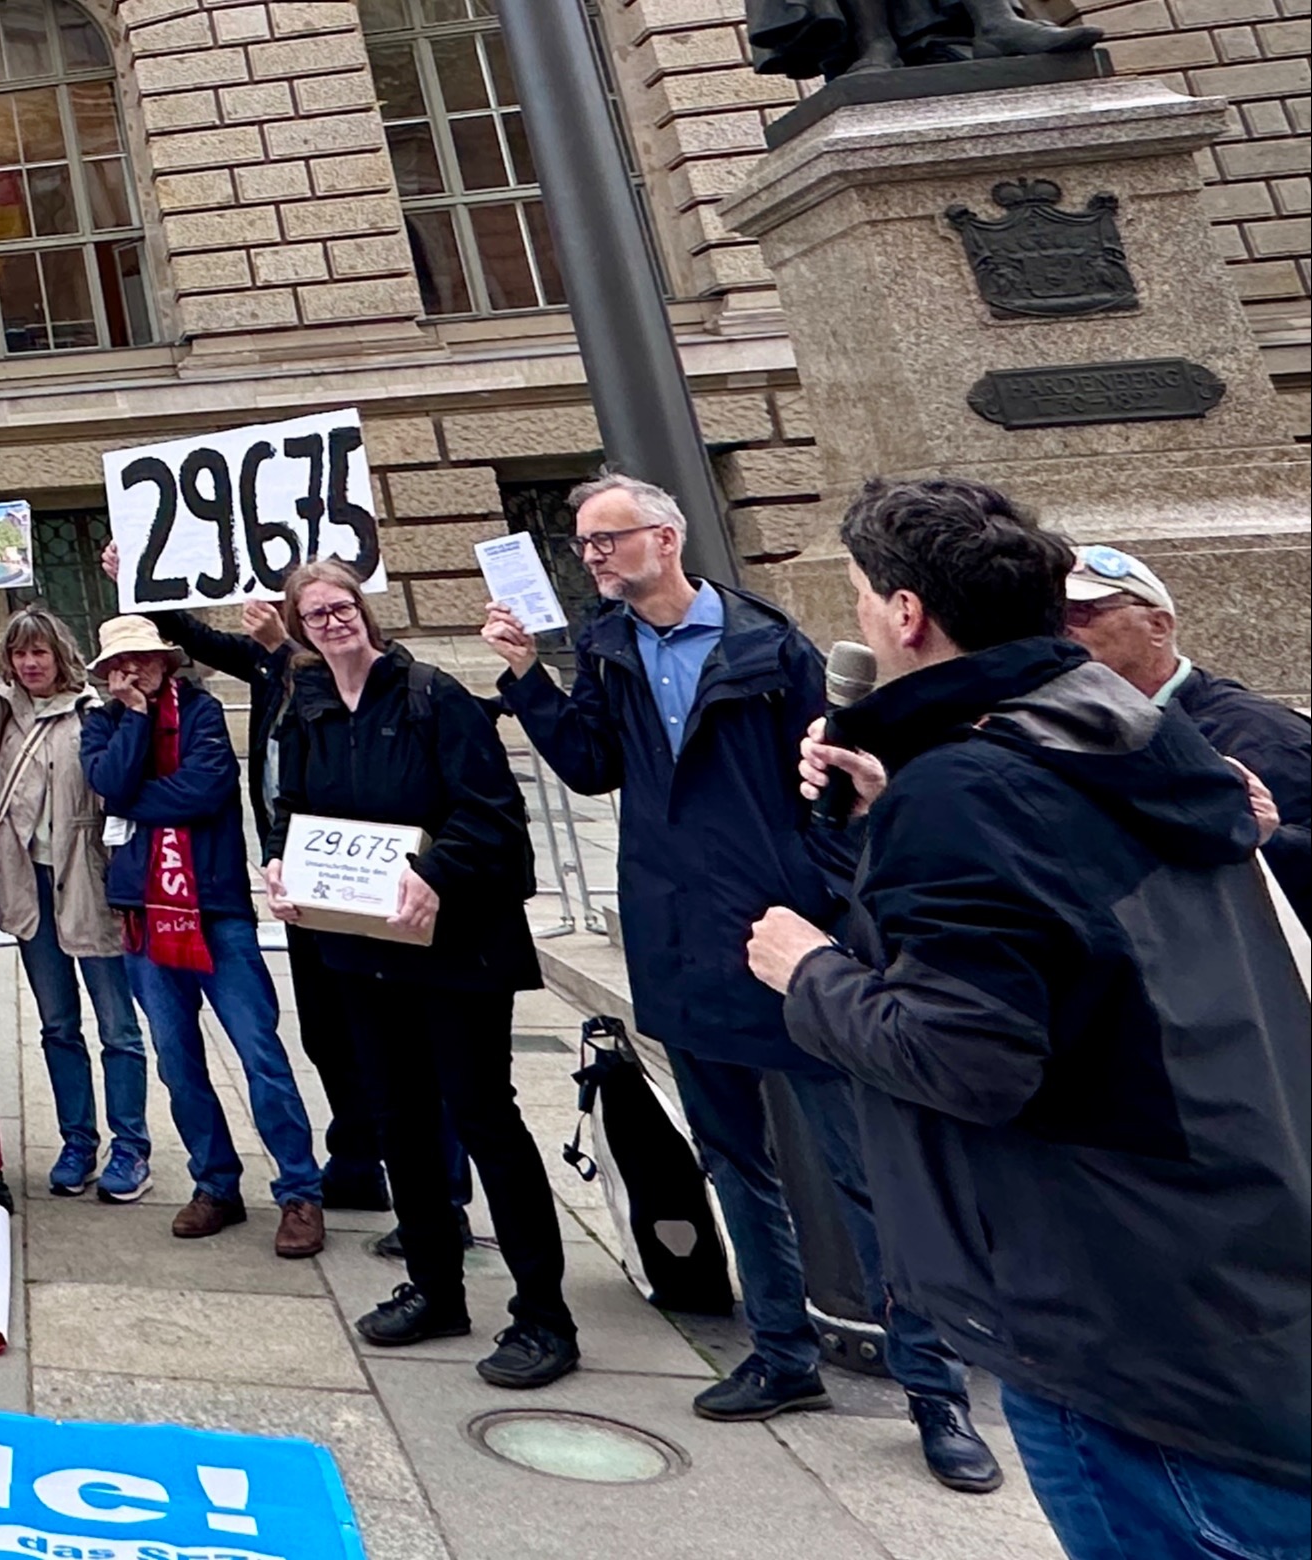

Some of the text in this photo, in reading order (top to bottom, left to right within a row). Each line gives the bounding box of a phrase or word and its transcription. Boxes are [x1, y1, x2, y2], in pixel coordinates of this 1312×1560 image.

[1009, 369, 1182, 397] HARDENBERG
[121, 426, 380, 603] 29.675
[303, 829, 402, 863] 29.675
[17, 1535, 116, 1560] das
